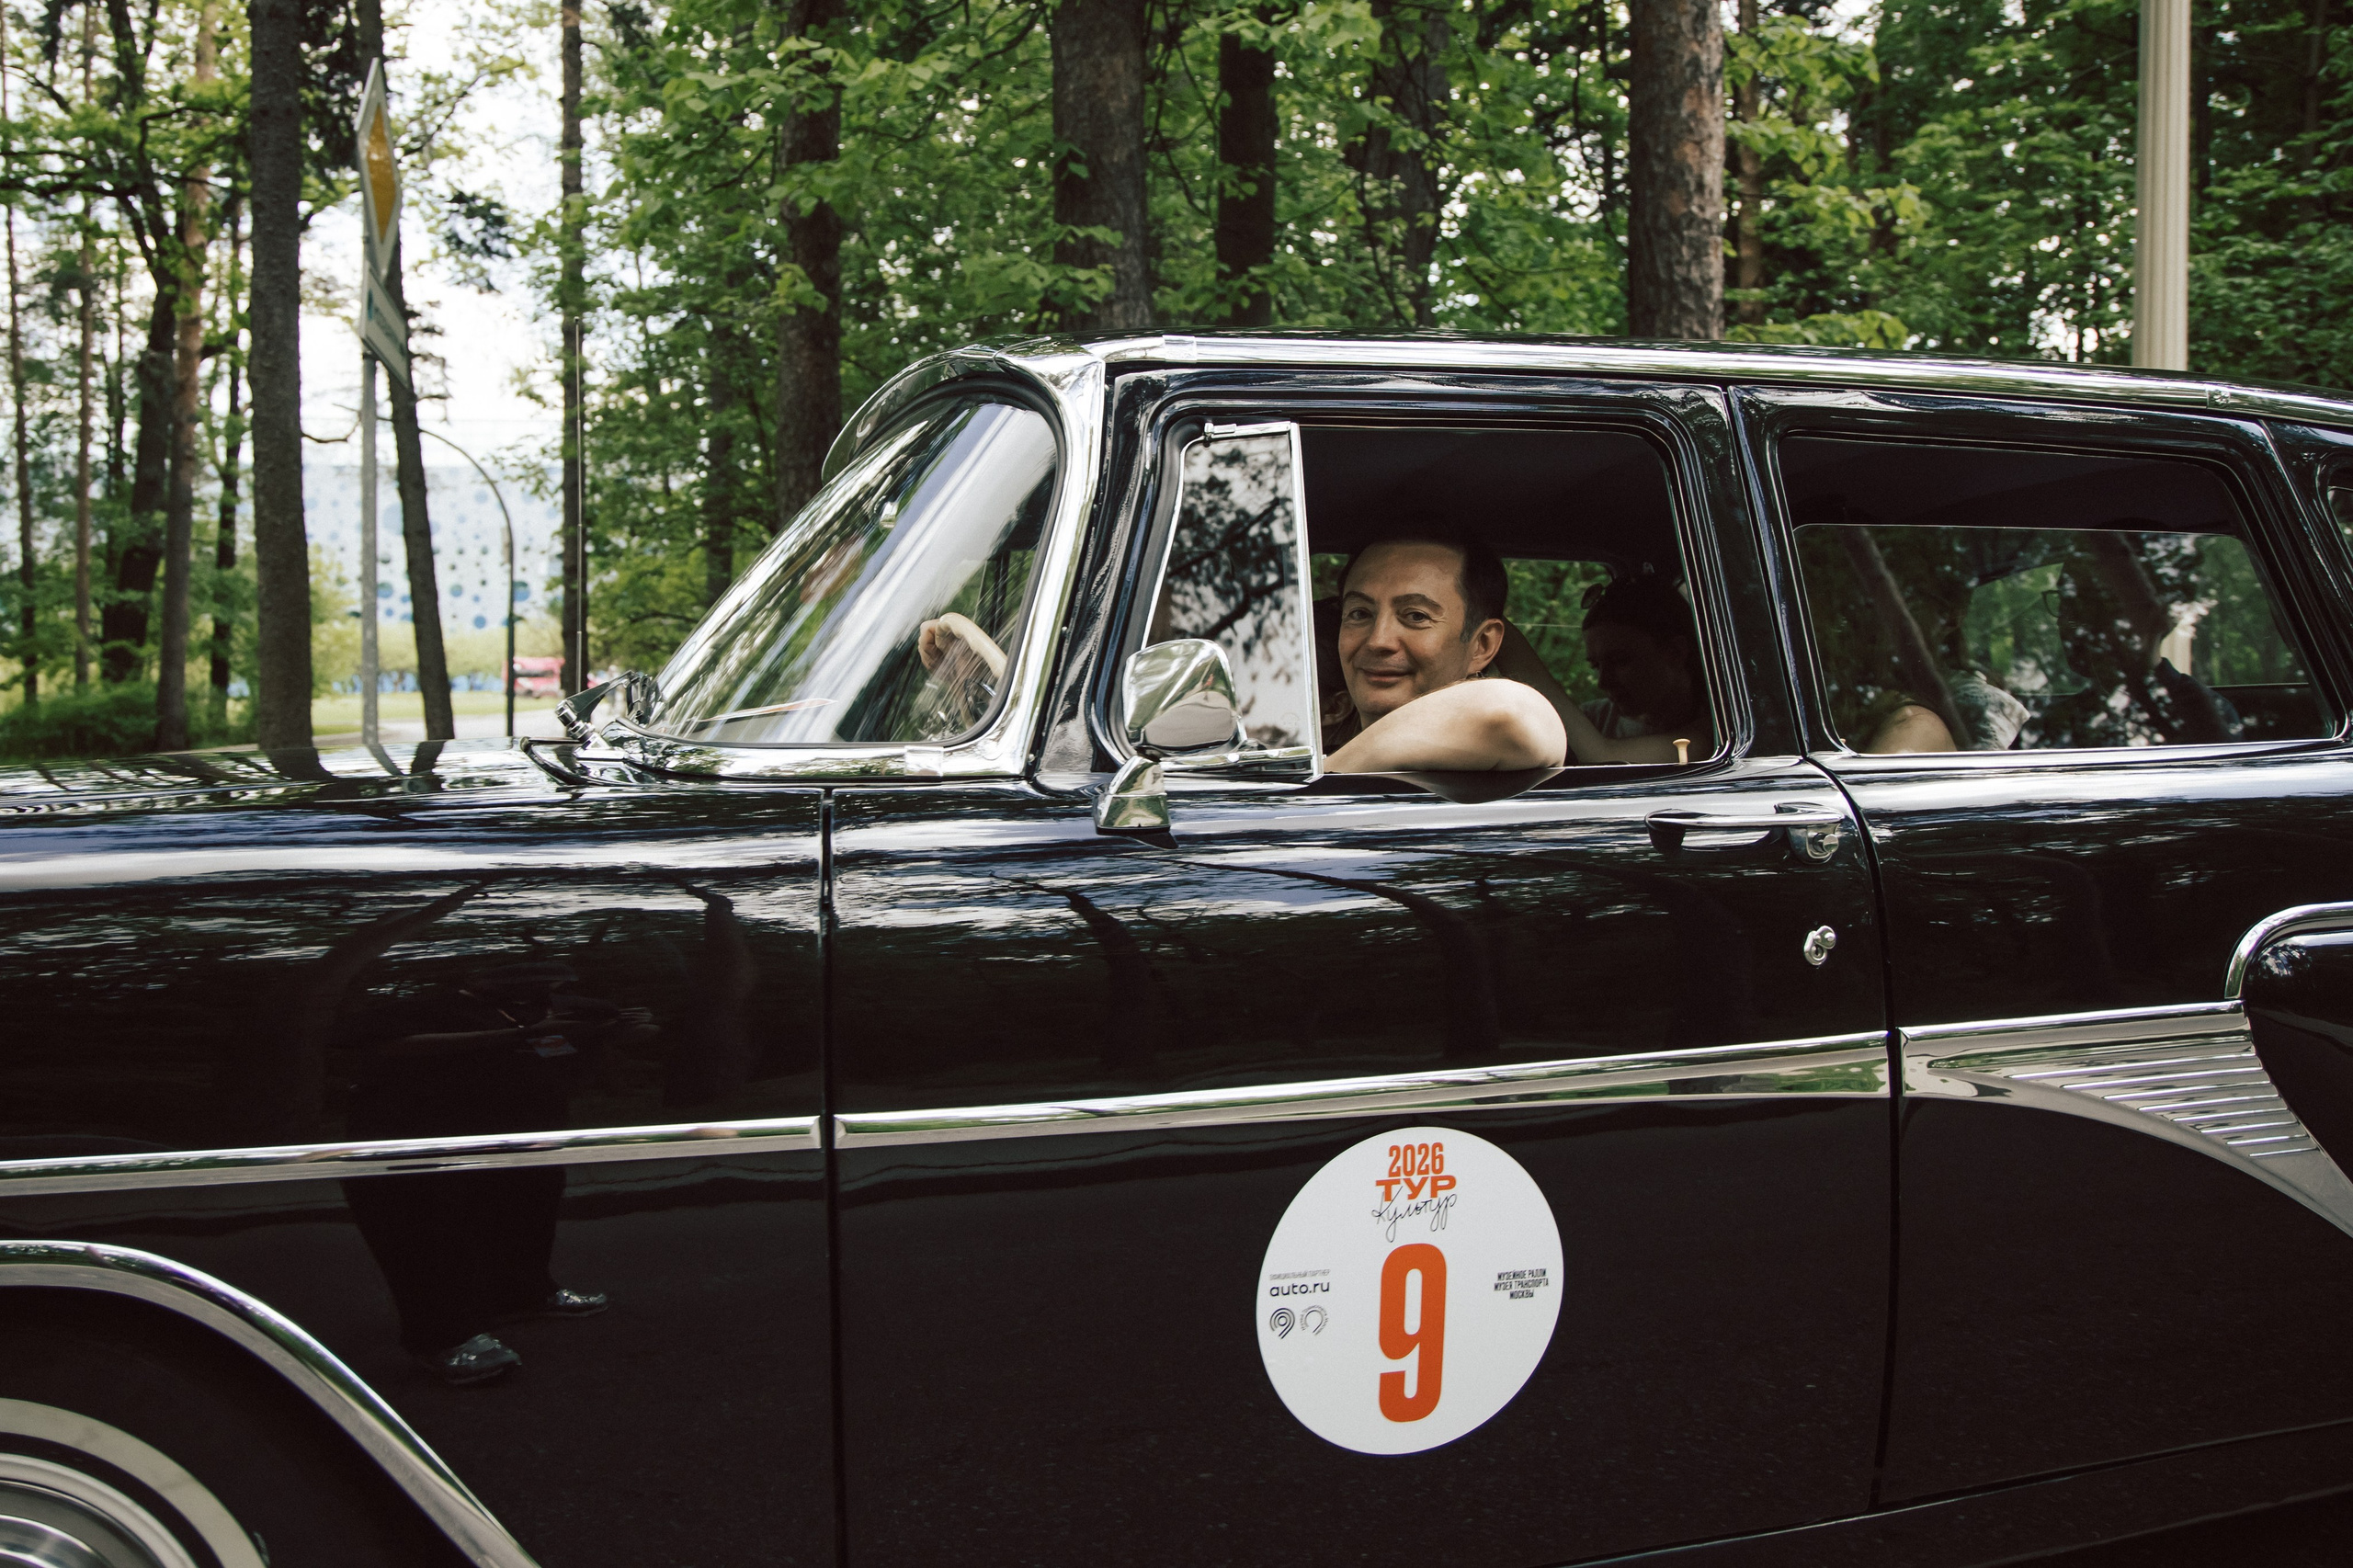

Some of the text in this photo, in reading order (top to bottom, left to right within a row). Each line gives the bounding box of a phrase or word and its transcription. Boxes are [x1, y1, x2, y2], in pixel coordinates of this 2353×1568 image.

[1388, 1142, 1444, 1177] 2026
[1375, 1175, 1457, 1202] ТУР
[1269, 1281, 1330, 1297] auto.ru
[1379, 1243, 1447, 1423] 9
